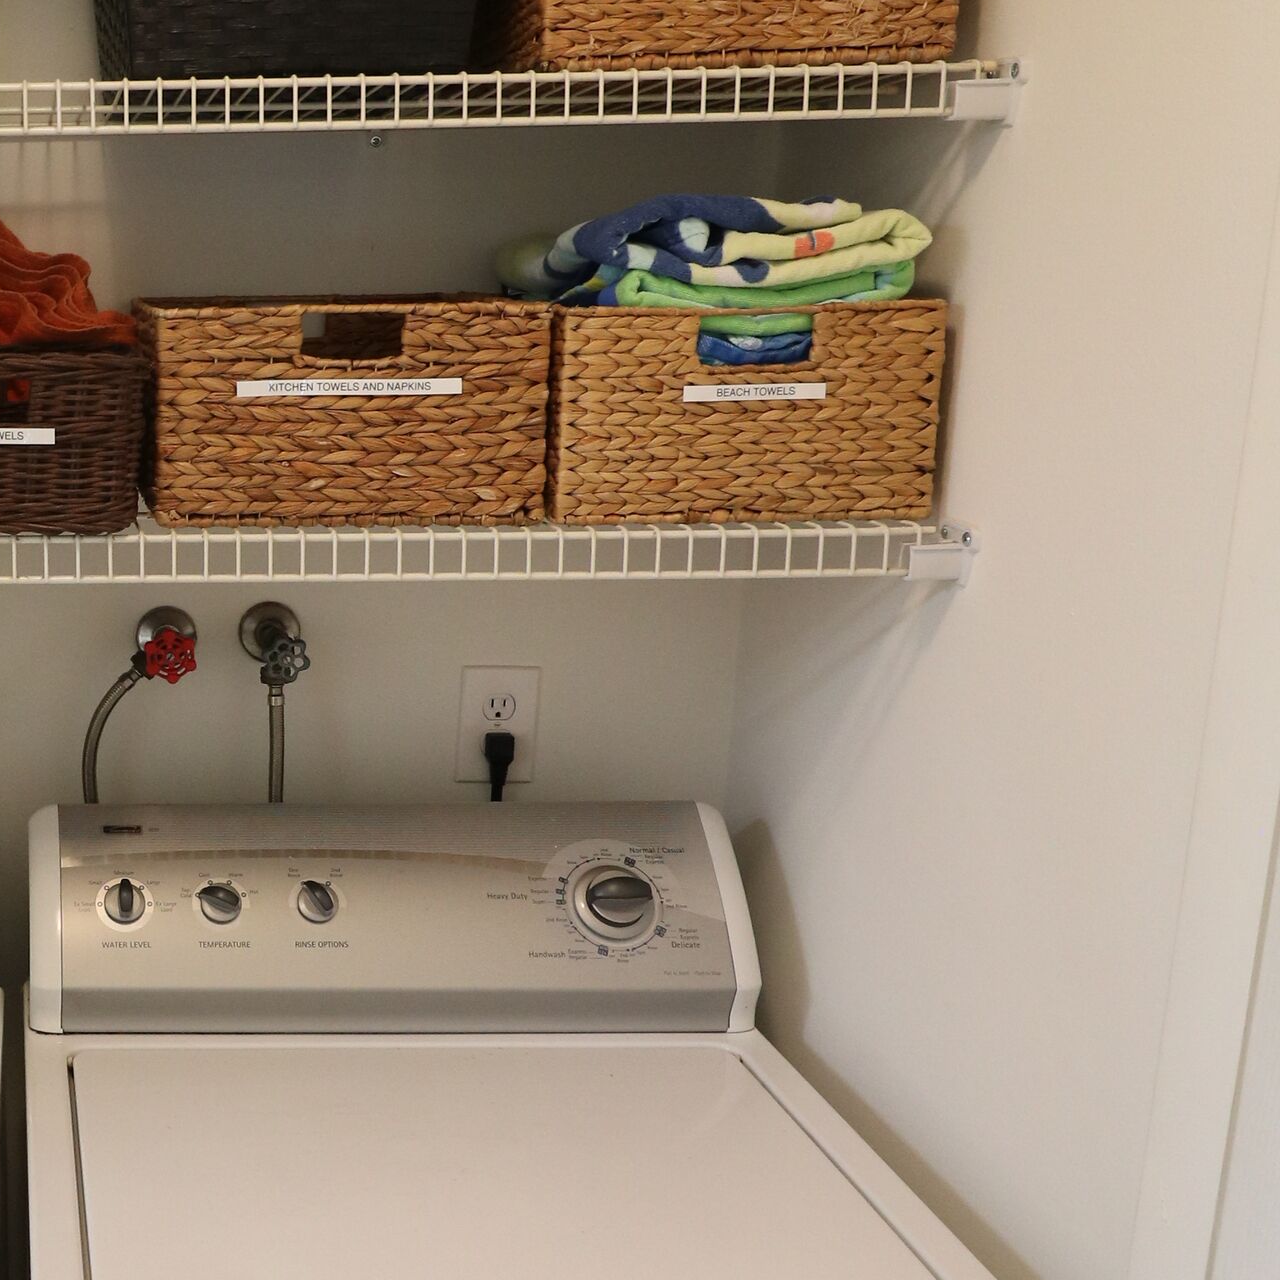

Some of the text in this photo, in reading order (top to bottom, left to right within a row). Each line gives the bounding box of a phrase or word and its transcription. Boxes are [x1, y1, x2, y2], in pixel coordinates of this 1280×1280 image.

[269, 381, 432, 392] KITCHEN TOWELS AND NAPKINS
[716, 386, 796, 397] BEACH TOWELS
[487, 892, 528, 901] Heavy Duty
[102, 941, 152, 949] WATER LEVEL
[198, 940, 251, 949] TEMPERATURE
[295, 940, 349, 949] RINSE OPTIONS
[671, 941, 701, 949] Delicate
[528, 950, 566, 958] Handwash
